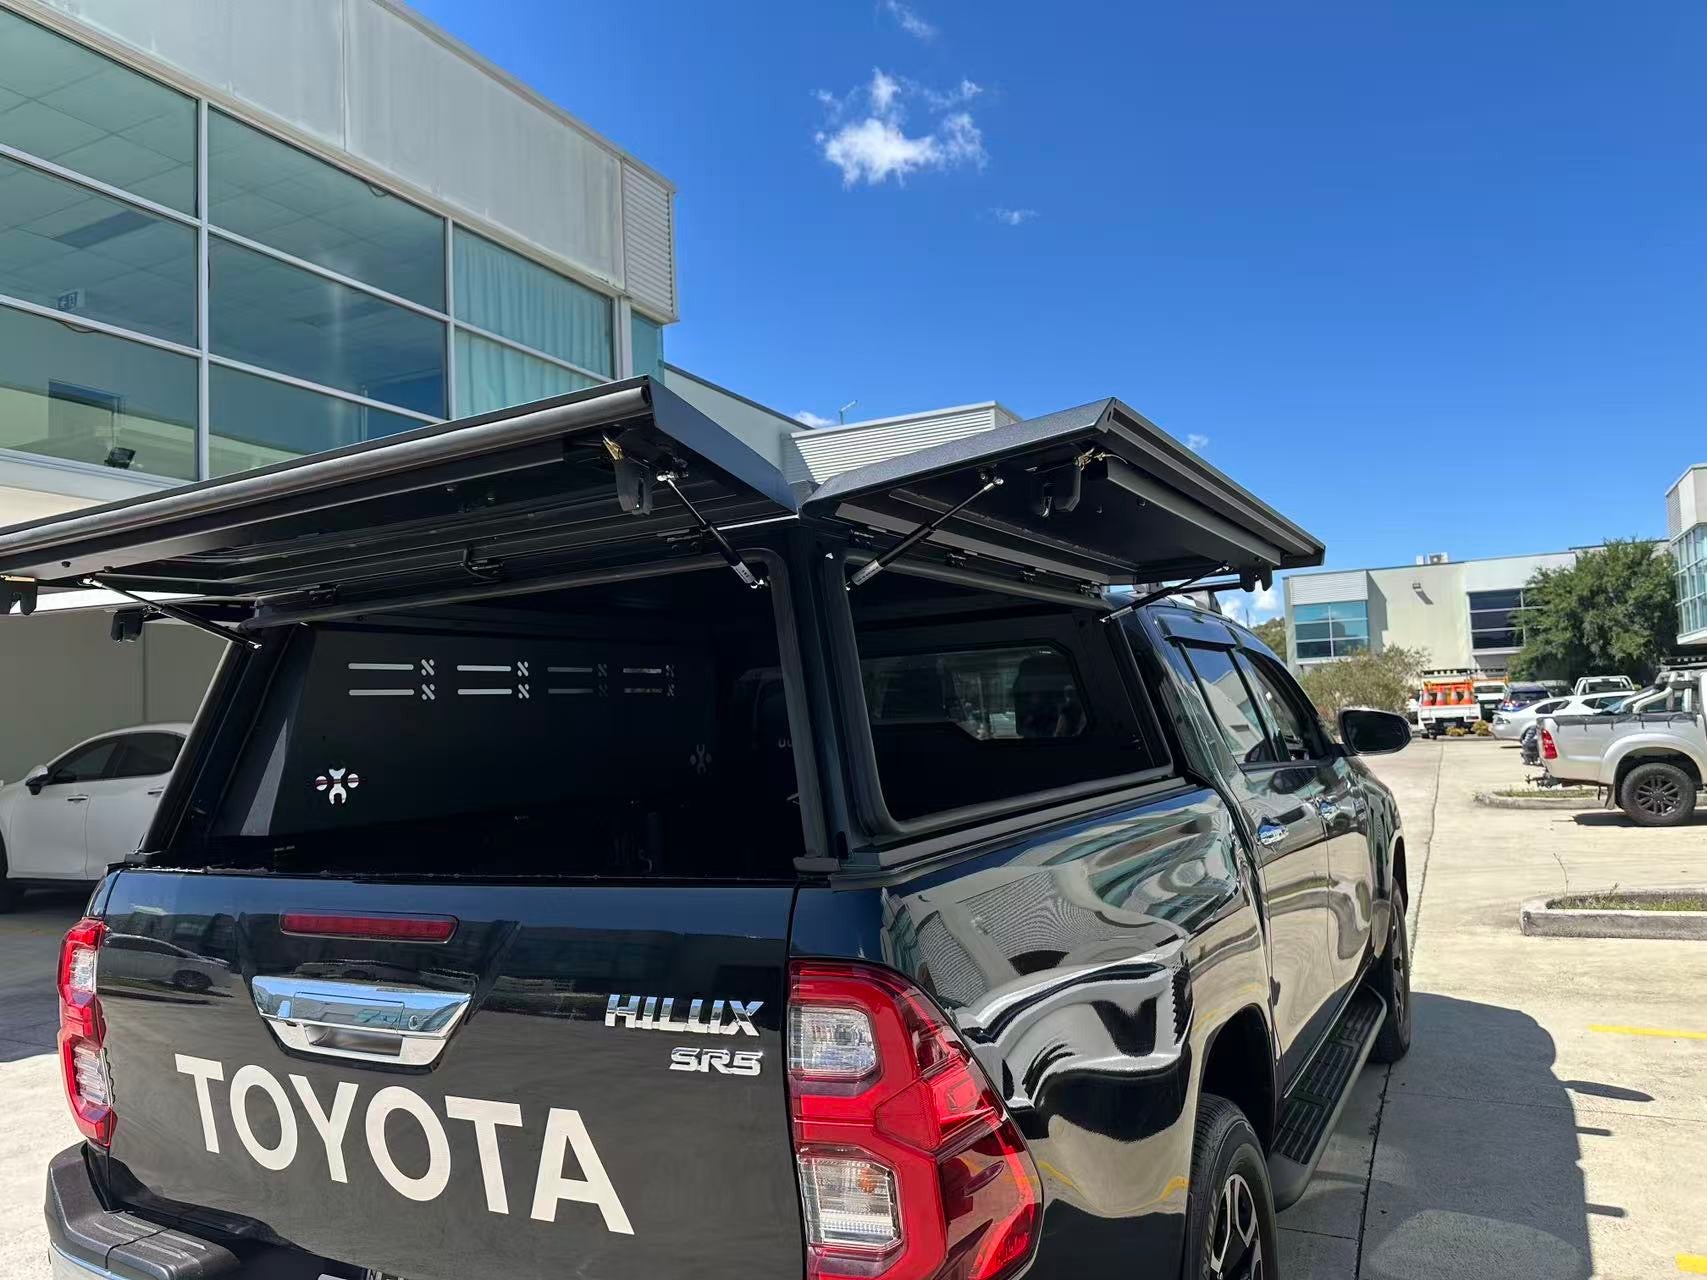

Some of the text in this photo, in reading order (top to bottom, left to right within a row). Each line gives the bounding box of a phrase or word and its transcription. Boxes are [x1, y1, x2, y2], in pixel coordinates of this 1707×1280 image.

[605, 994, 764, 1037] HILUX
[669, 1046, 764, 1076] SR5
[174, 1053, 635, 1235] TOYOTA
